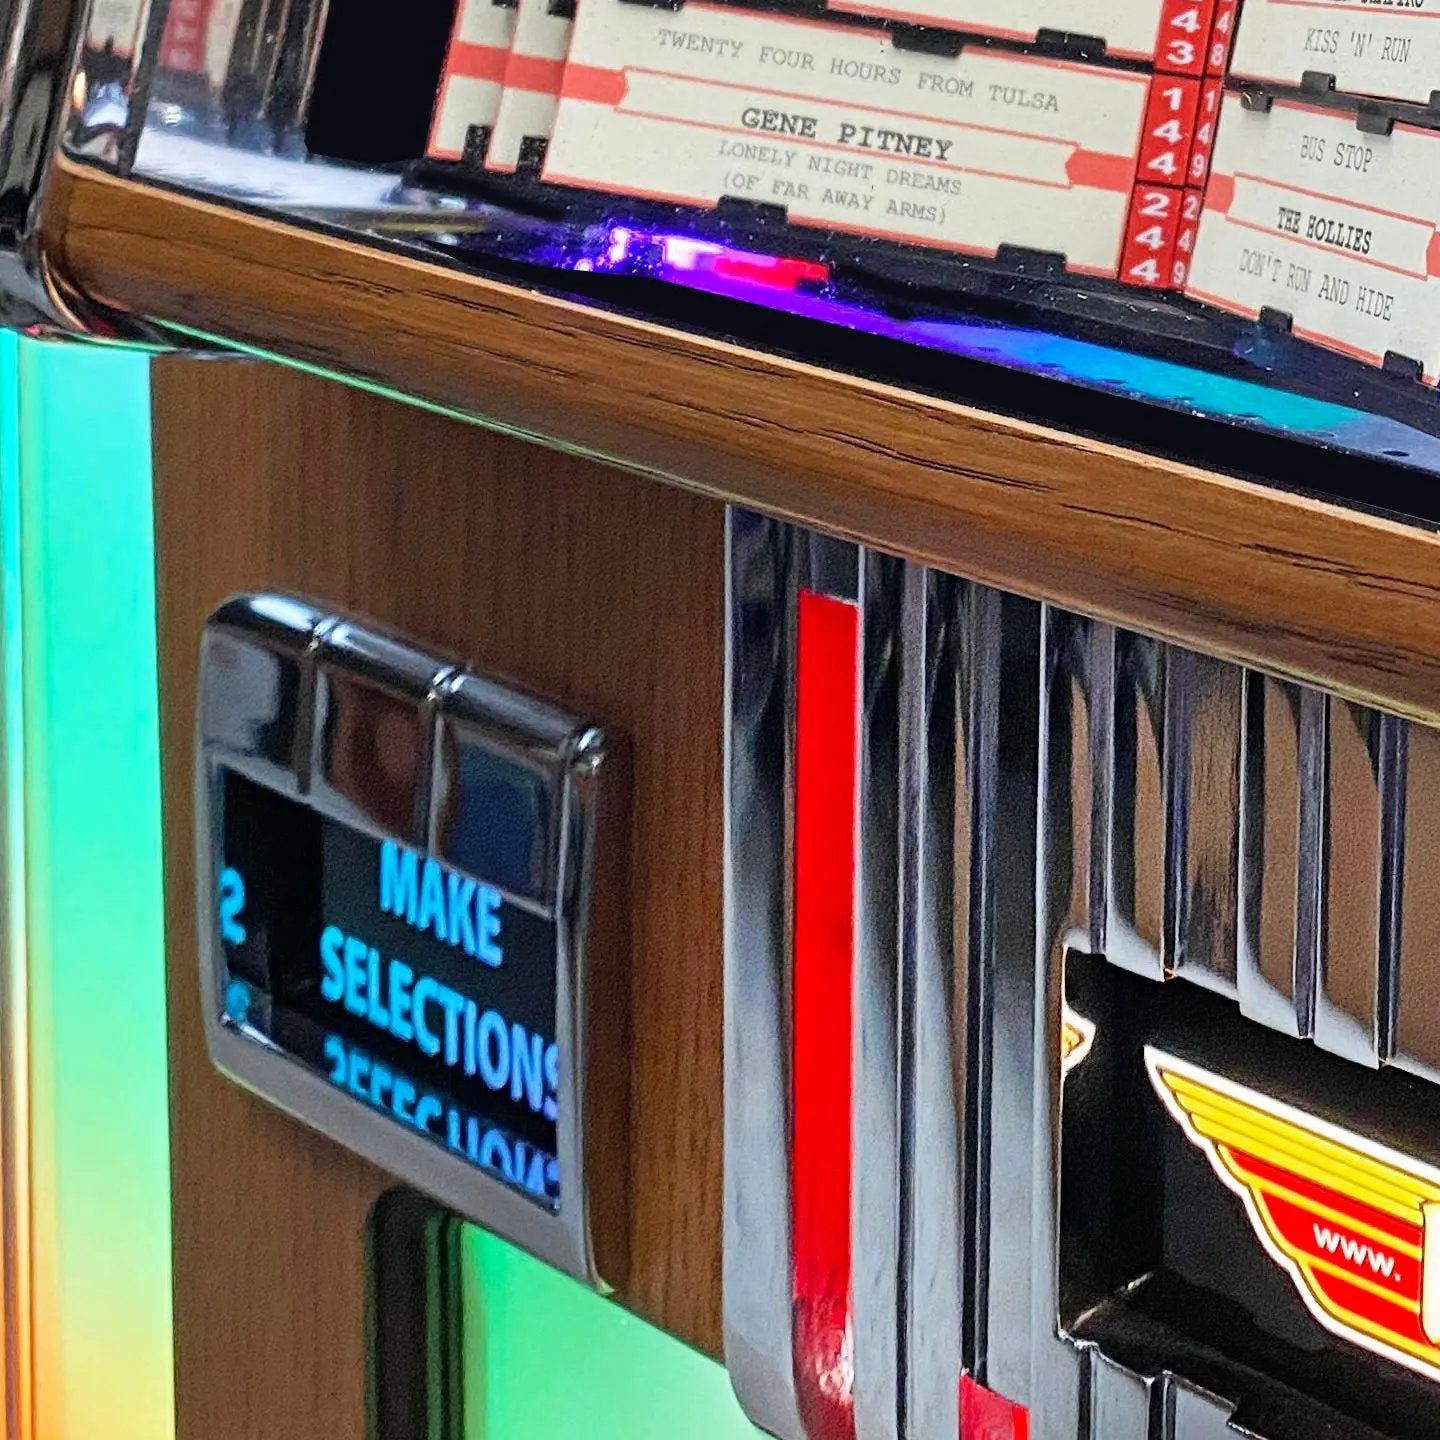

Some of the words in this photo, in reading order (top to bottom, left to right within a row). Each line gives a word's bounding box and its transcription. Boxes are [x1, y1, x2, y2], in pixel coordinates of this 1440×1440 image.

[658, 28, 744, 59] TWENTY
[758, 45, 815, 71] FOUR
[828, 57, 902, 87] HOURS
[916, 71, 975, 98] FROM
[988, 84, 1059, 113] TULSA
[1304, 27, 1341, 54] KISS
[1350, 31, 1373, 57] 'N'
[1380, 36, 1412, 64] RUN
[741, 107, 818, 139] GENE
[836, 122, 954, 162] PITNEY
[1300, 134, 1326, 163] BUS
[1333, 142, 1373, 173] STOP
[718, 139, 798, 168] LONELY
[807, 154, 874, 181] NIGHT
[885, 168, 962, 196] DREAMS
[723, 171, 761, 190] (OF
[771, 178, 810, 201] FAR
[820, 188, 876, 212] AWAY
[885, 198, 946, 226] ARMS)
[1277, 206, 1302, 234] THE
[1305, 215, 1372, 255] HOLLIES
[1239, 248, 1282, 283] DON'T
[1286, 263, 1312, 292] RUN
[1317, 273, 1350, 306] AND
[1355, 285, 1394, 322] HIDE
[380, 839, 503, 967] MAKE
[1313, 1223, 1401, 1282] www.
